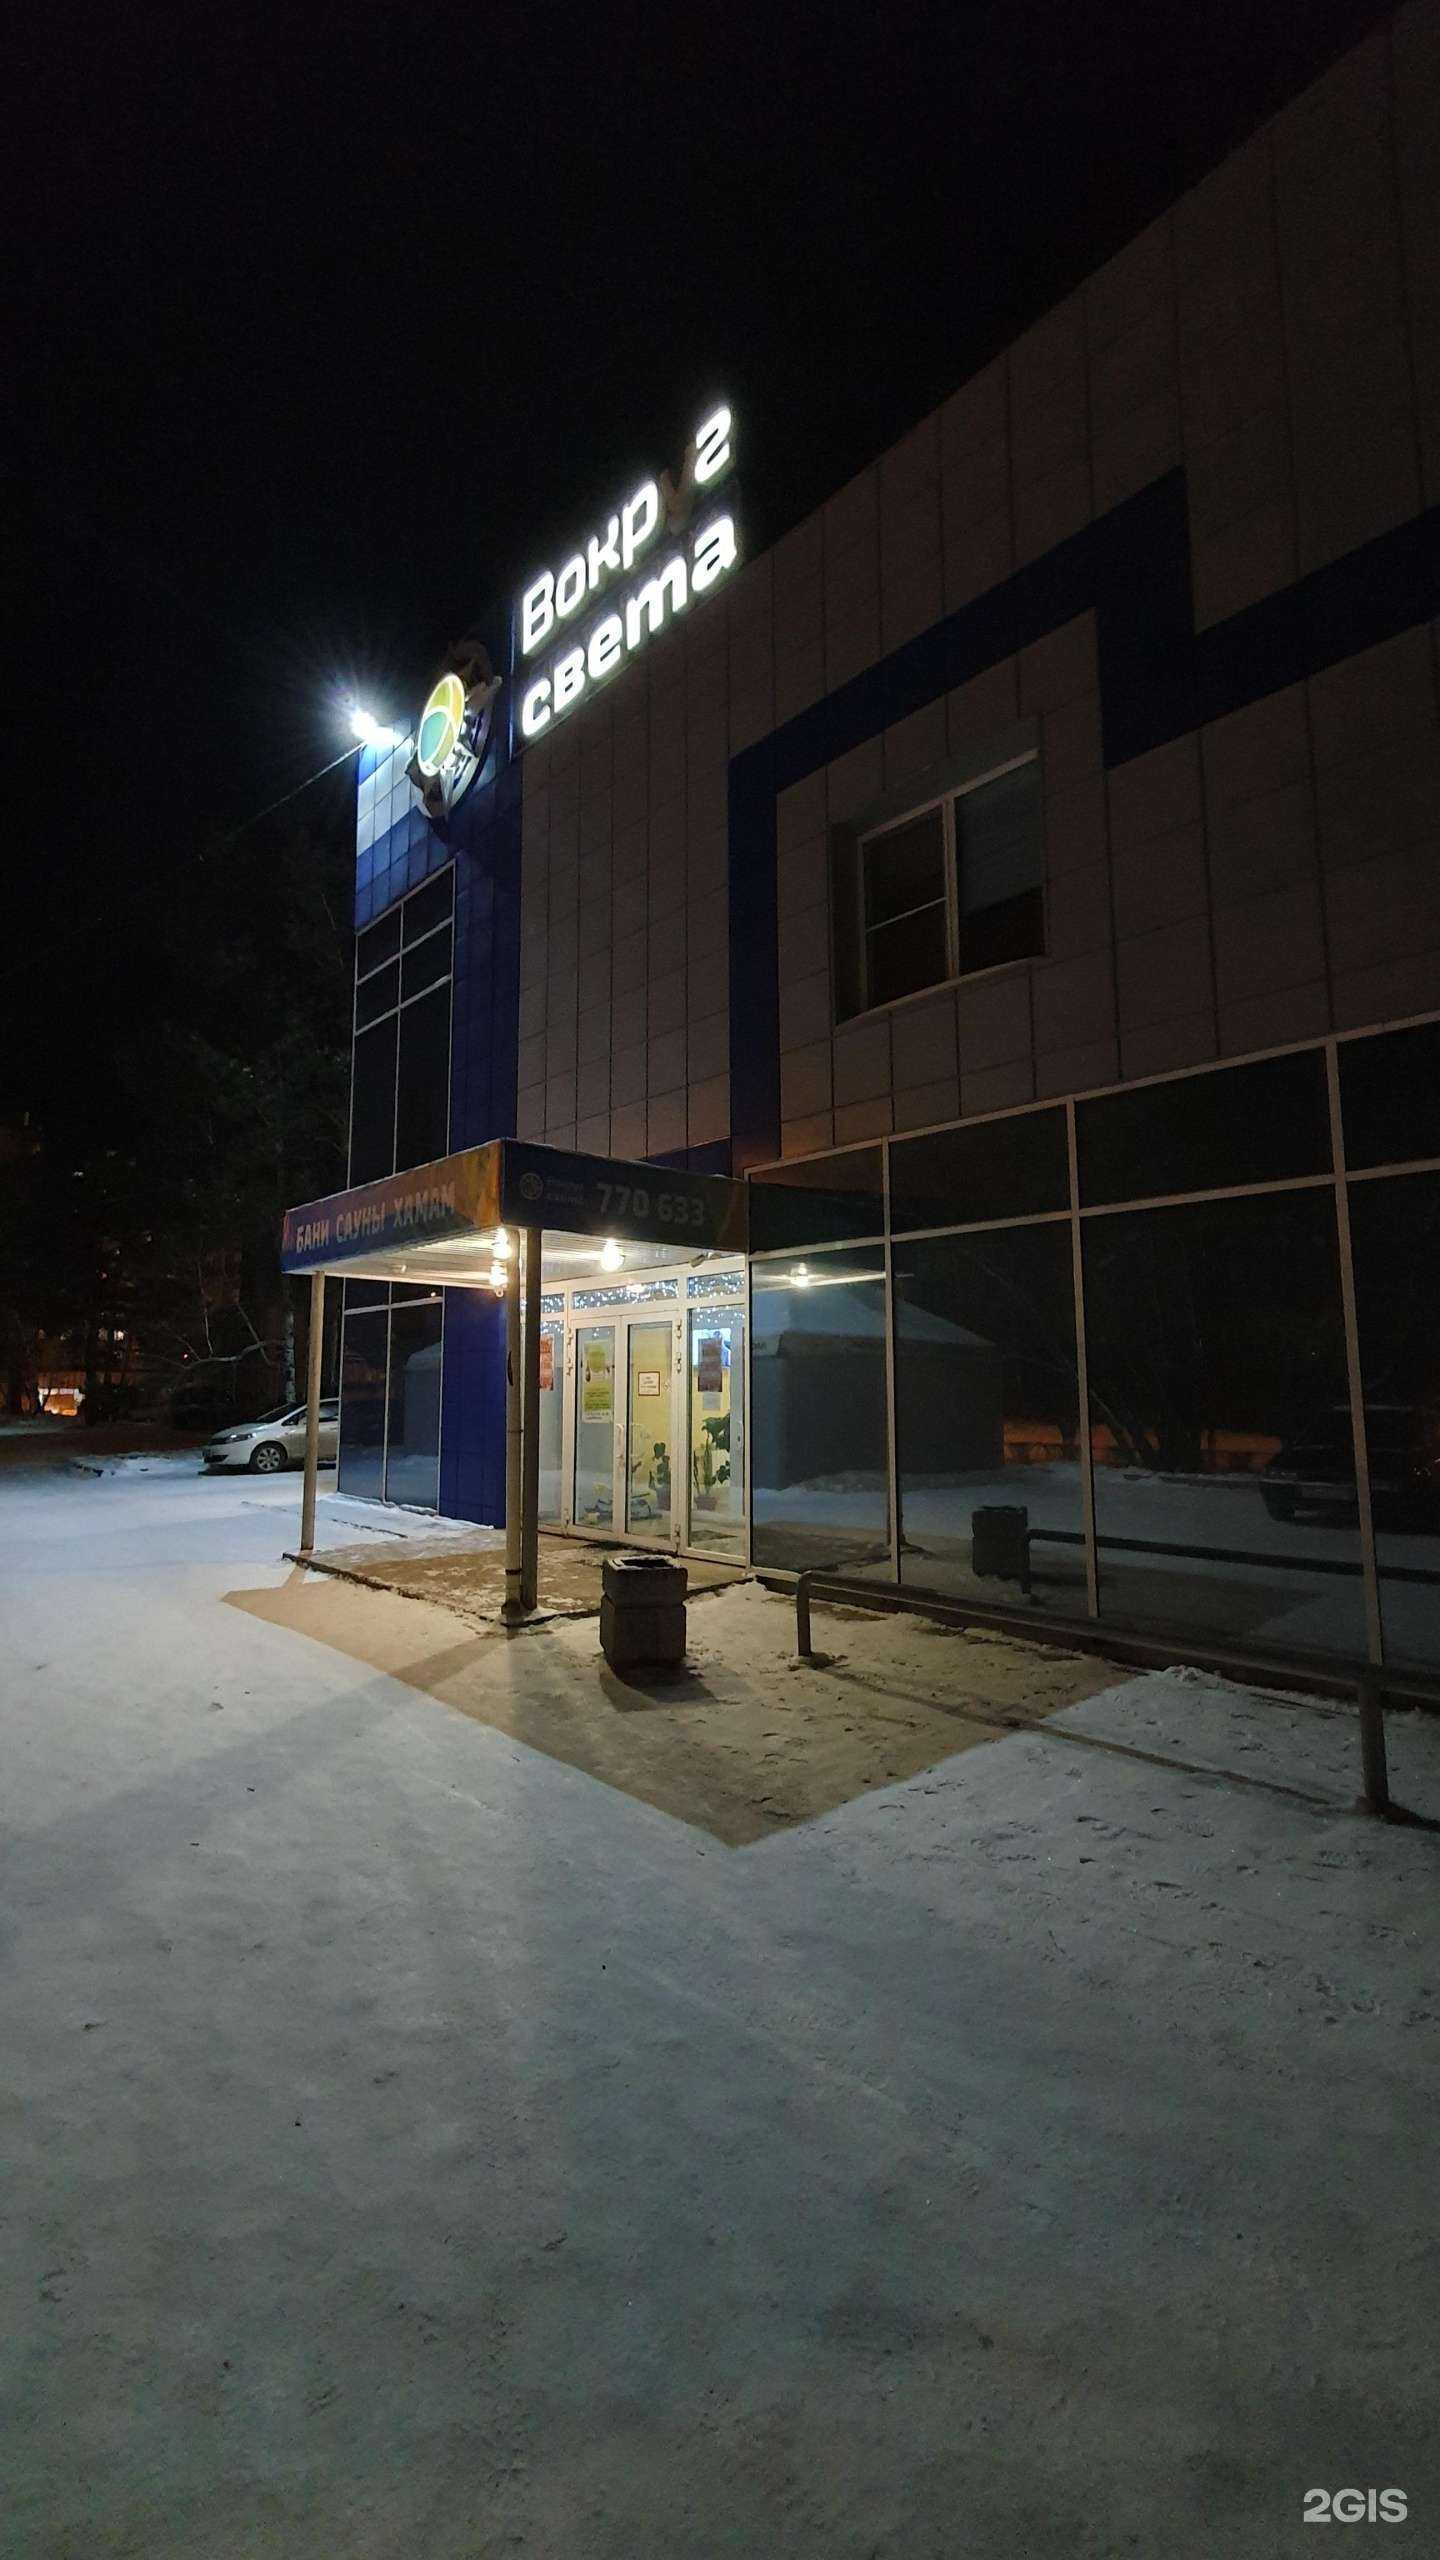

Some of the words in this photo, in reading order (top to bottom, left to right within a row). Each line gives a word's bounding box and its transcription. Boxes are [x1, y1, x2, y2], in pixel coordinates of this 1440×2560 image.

[521, 515, 738, 737] света
[296, 1219, 329, 1253] БАНИ
[336, 1199, 386, 1243] САУНЫ
[393, 1182, 456, 1228] ХАМАМ
[595, 1182, 650, 1217] 770
[656, 1192, 705, 1226] 633
